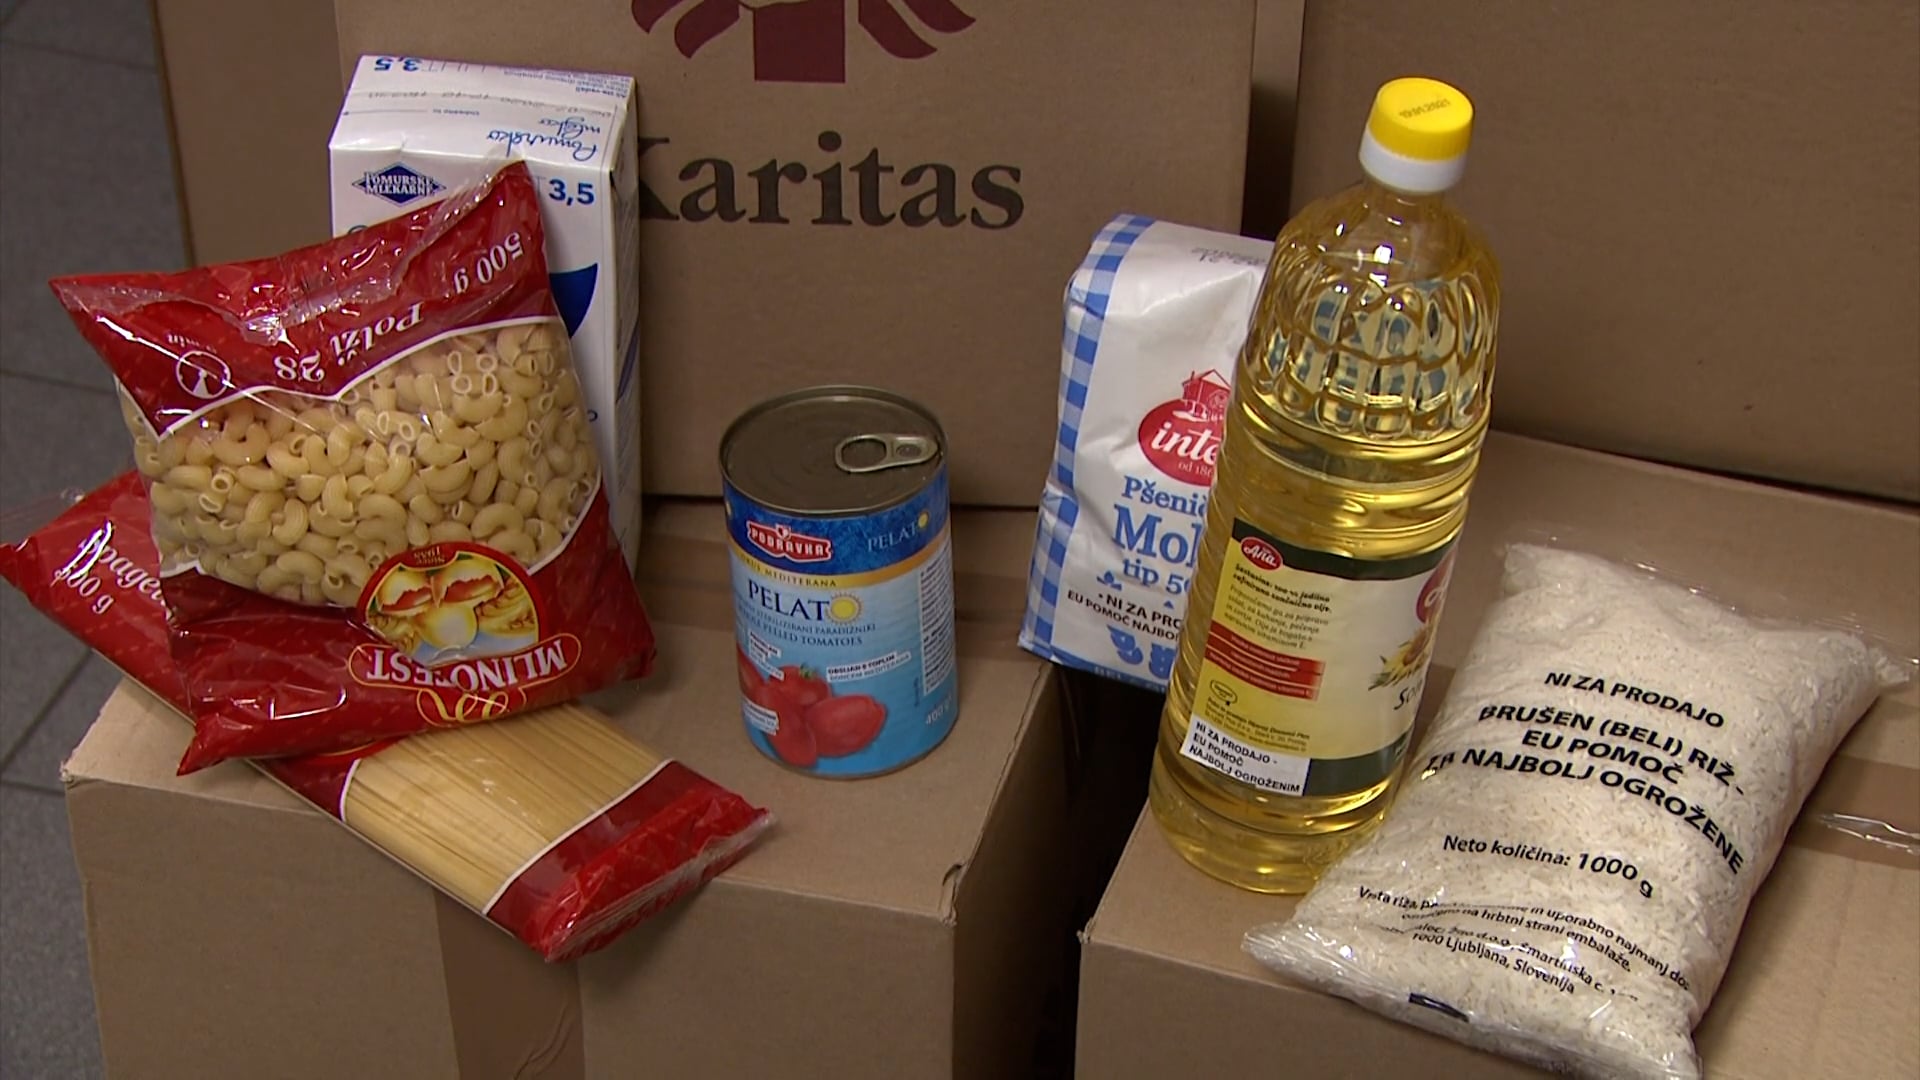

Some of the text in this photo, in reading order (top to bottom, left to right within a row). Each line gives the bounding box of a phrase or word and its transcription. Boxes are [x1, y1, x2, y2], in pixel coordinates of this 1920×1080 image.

[486, 129, 597, 162] Pomursko
[548, 178, 595, 206] 3,5
[453, 231, 526, 294] 500 g
[274, 303, 425, 384] Polži 28
[1178, 461, 1193, 473] od
[750, 527, 825, 557] PODRAVKA
[1243, 544, 1278, 568] Ana
[765, 569, 837, 588] MEDITERANA
[1122, 558, 1160, 588] tip
[92, 594, 115, 615] g
[1067, 589, 1084, 604] EU
[1085, 597, 1130, 626] POMOČ
[1106, 593, 1123, 611] NI
[1125, 602, 1148, 620] ZA
[801, 635, 863, 648] TOMATOES
[1544, 671, 1724, 728] NI ZA PRODAJO
[1193, 732, 1245, 767] EU POMOČ
[1195, 721, 1206, 734] NI
[1207, 728, 1219, 743] ZA
[1221, 735, 1271, 764] PRODAJO
[1478, 704, 1594, 732] BRUŠEN
[1599, 718, 1684, 757] (BELI)
[1688, 747, 1736, 787] RIŽ
[1522, 729, 1685, 784] EU POMOČ
[1189, 744, 1301, 793] NAJBOLJ OGROŽENIM
[1461, 748, 1595, 780] NAJBOLJ
[1600, 769, 1745, 875] OGROŽENE
[1443, 834, 1653, 899] Neto količina: 1000 g
[1481, 907, 1525, 927] hrbtni
[1524, 918, 1566, 935] strani
[1565, 929, 1632, 973] embalaže.
[1546, 908, 1614, 939] uporabno
[1614, 933, 1670, 975] najmanj
[1445, 936, 1511, 968] Ljubljana,
[1512, 956, 1575, 995] Slovenija
